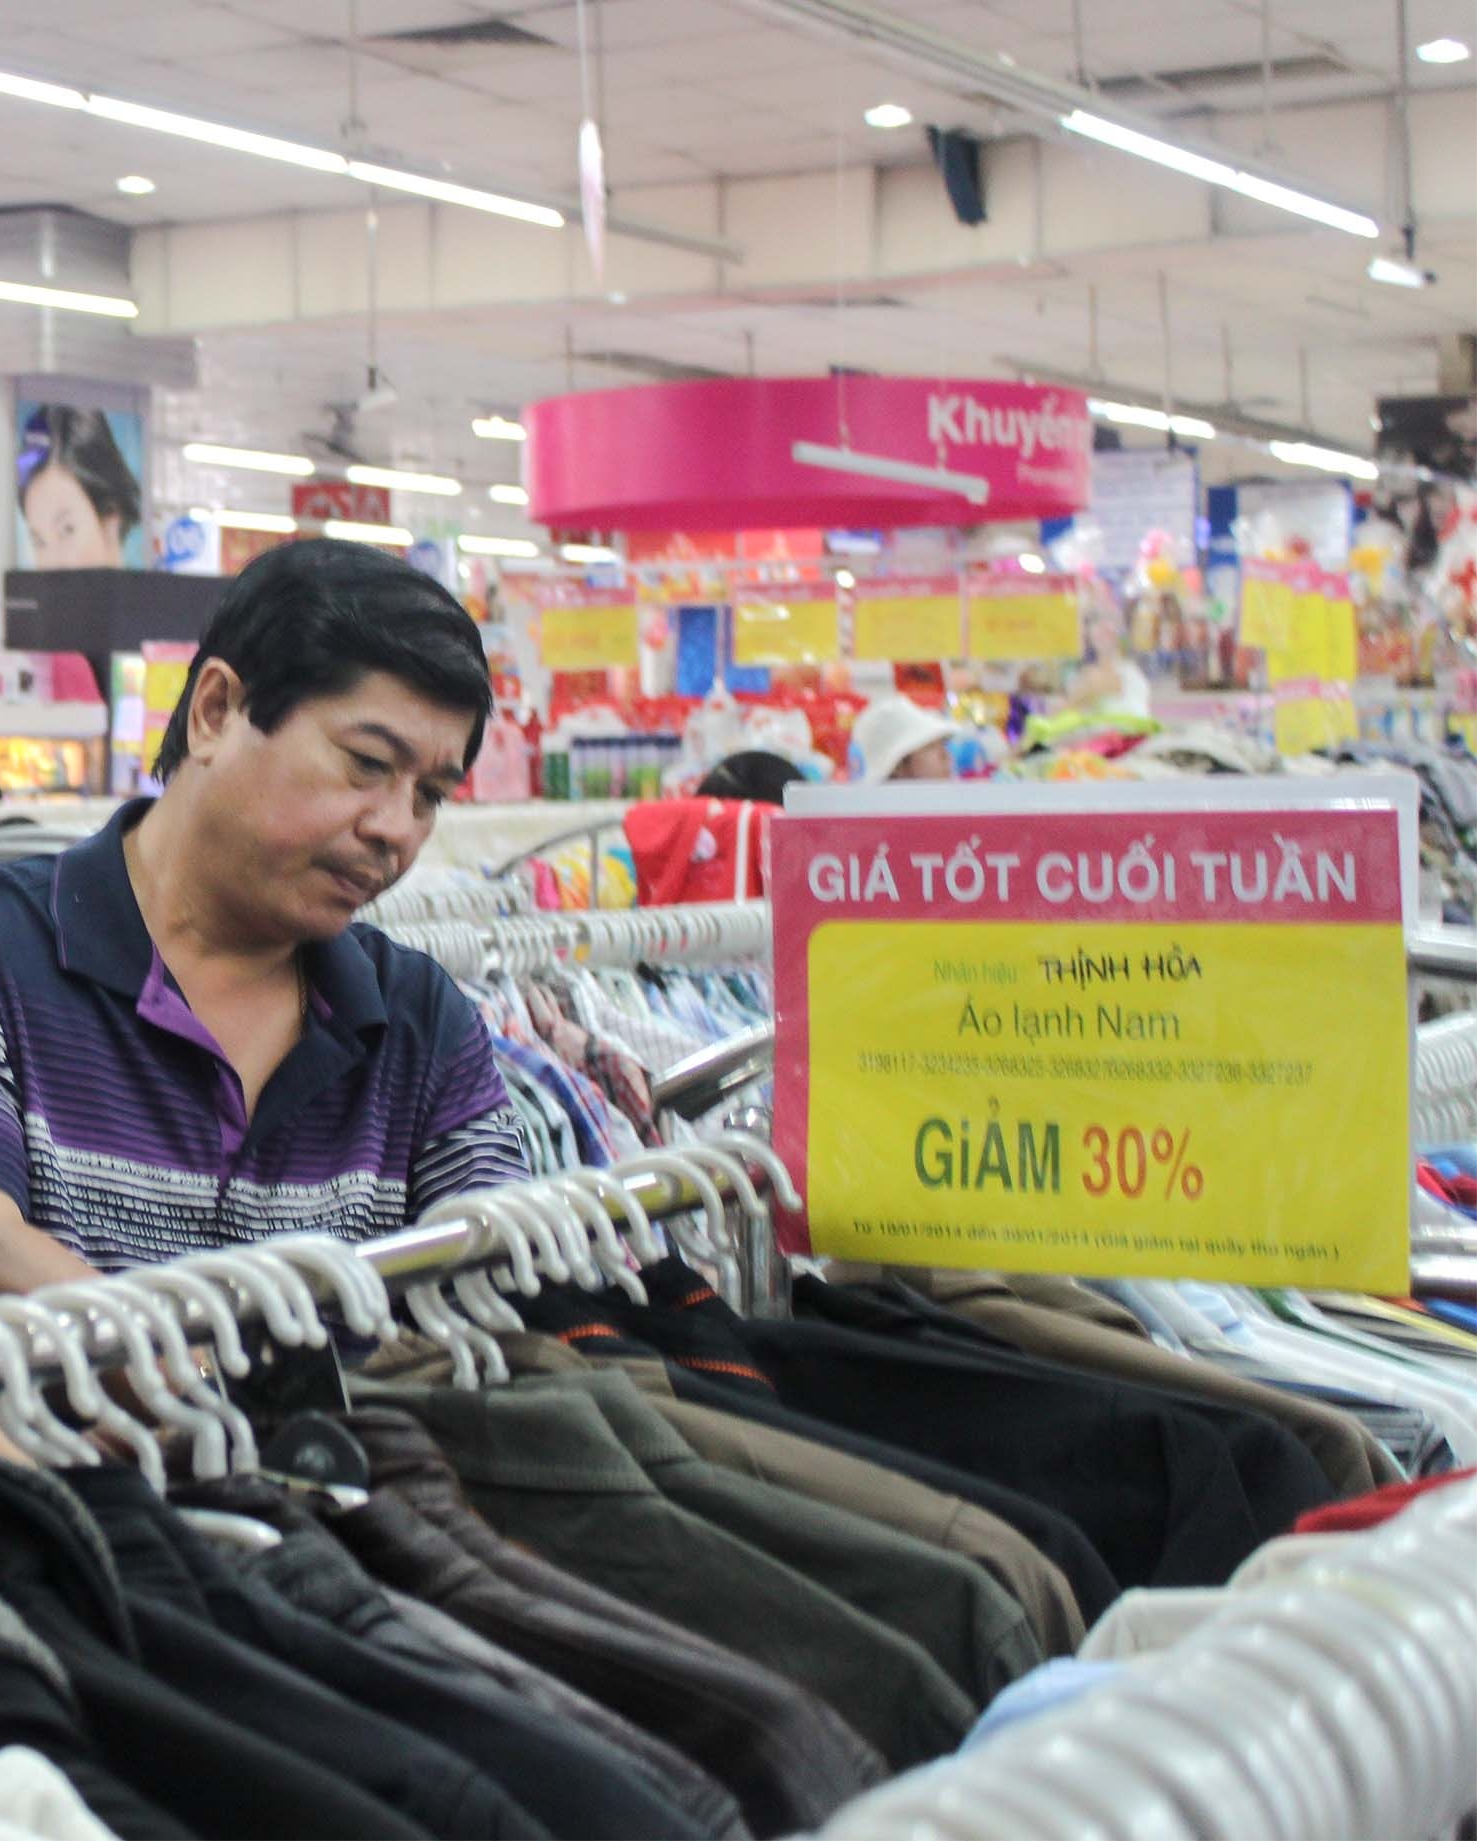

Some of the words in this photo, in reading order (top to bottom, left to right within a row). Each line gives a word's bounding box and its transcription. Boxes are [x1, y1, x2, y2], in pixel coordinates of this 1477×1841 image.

[807, 842, 900, 903] GIÁ
[911, 834, 1020, 903] TỐT
[1035, 833, 1176, 903] CUỐI
[1191, 832, 1358, 903] TUẦN
[958, 992, 1003, 1037] Áo
[1013, 1001, 1085, 1046] lạnh
[1097, 1003, 1181, 1041] Nam
[1081, 1123, 1205, 1201] 30%
